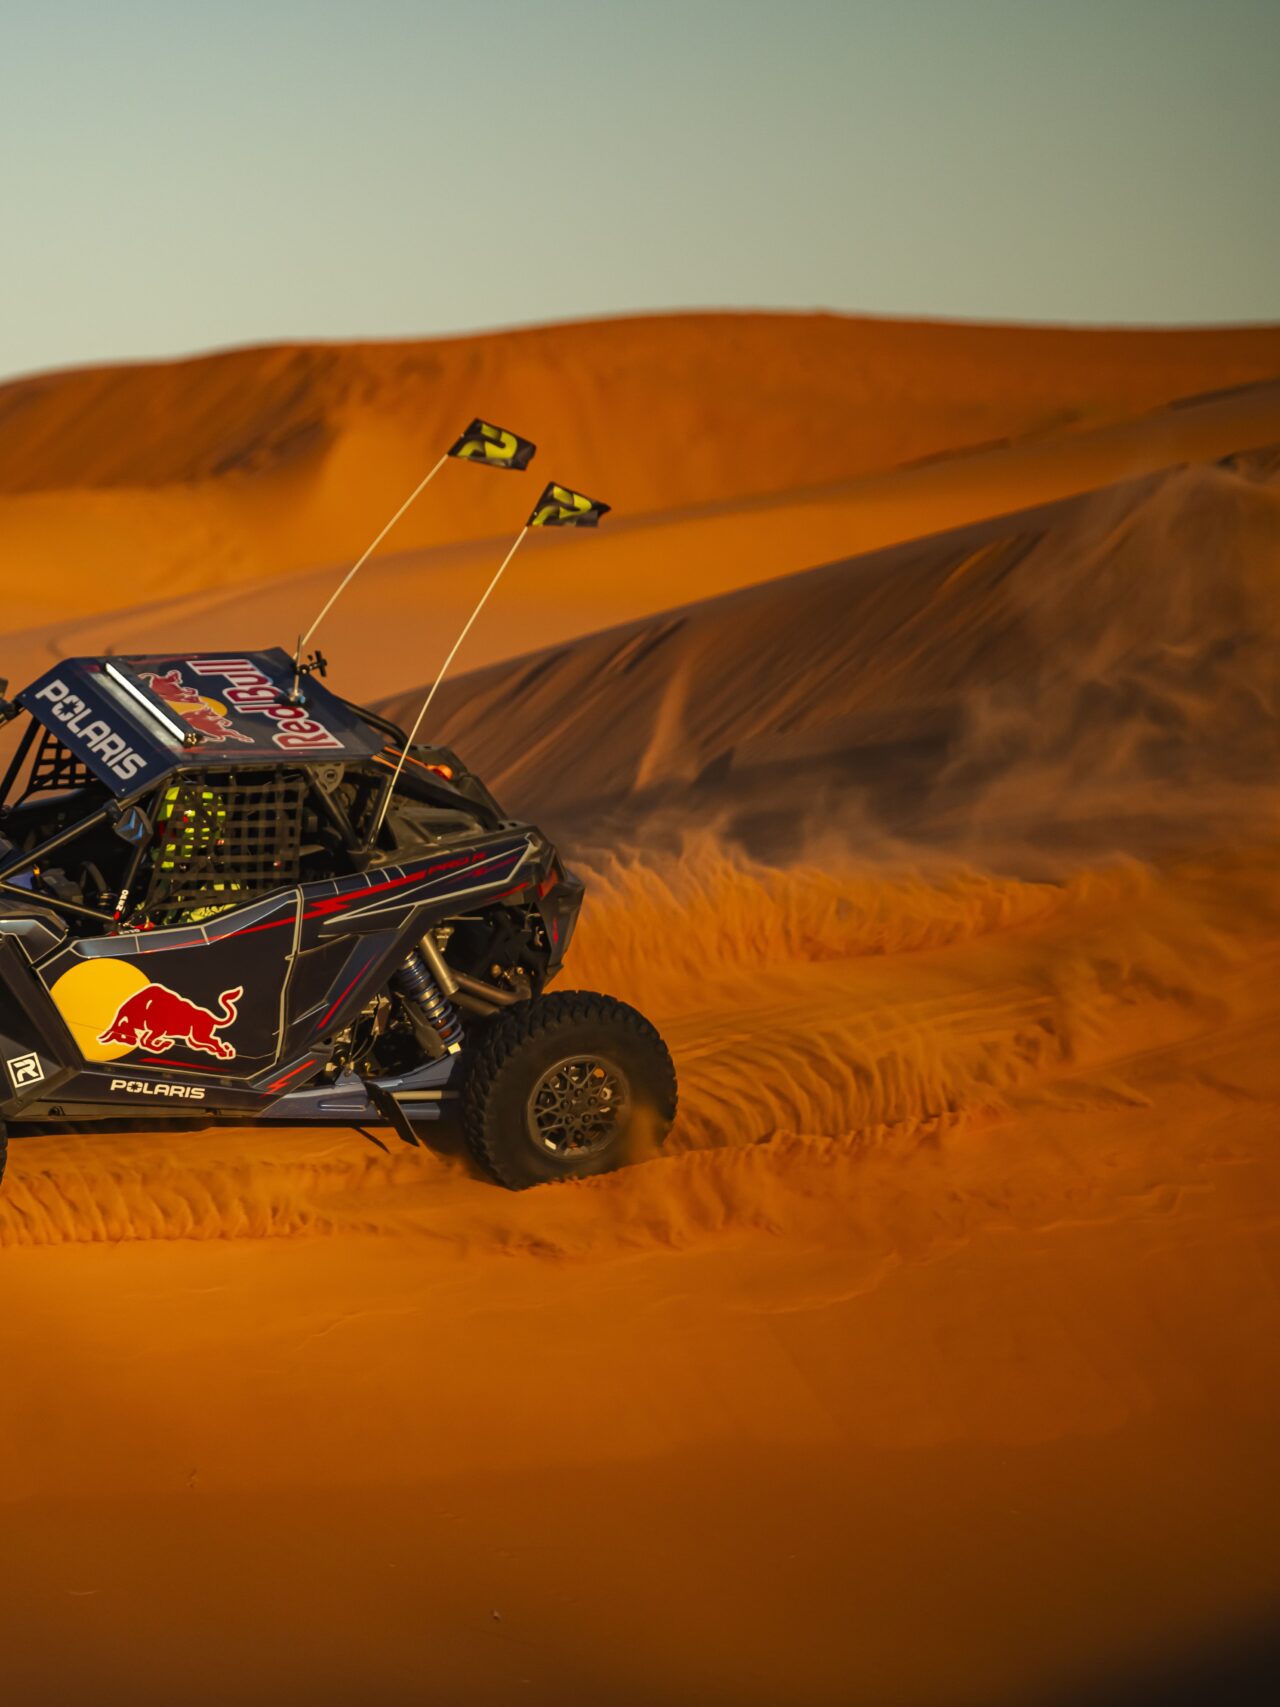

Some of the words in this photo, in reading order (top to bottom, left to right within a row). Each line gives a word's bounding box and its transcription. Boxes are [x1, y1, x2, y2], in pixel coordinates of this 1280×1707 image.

[35, 679, 148, 781] POLARIS
[13, 1060, 40, 1083] R
[110, 1079, 206, 1100] POLARIS
